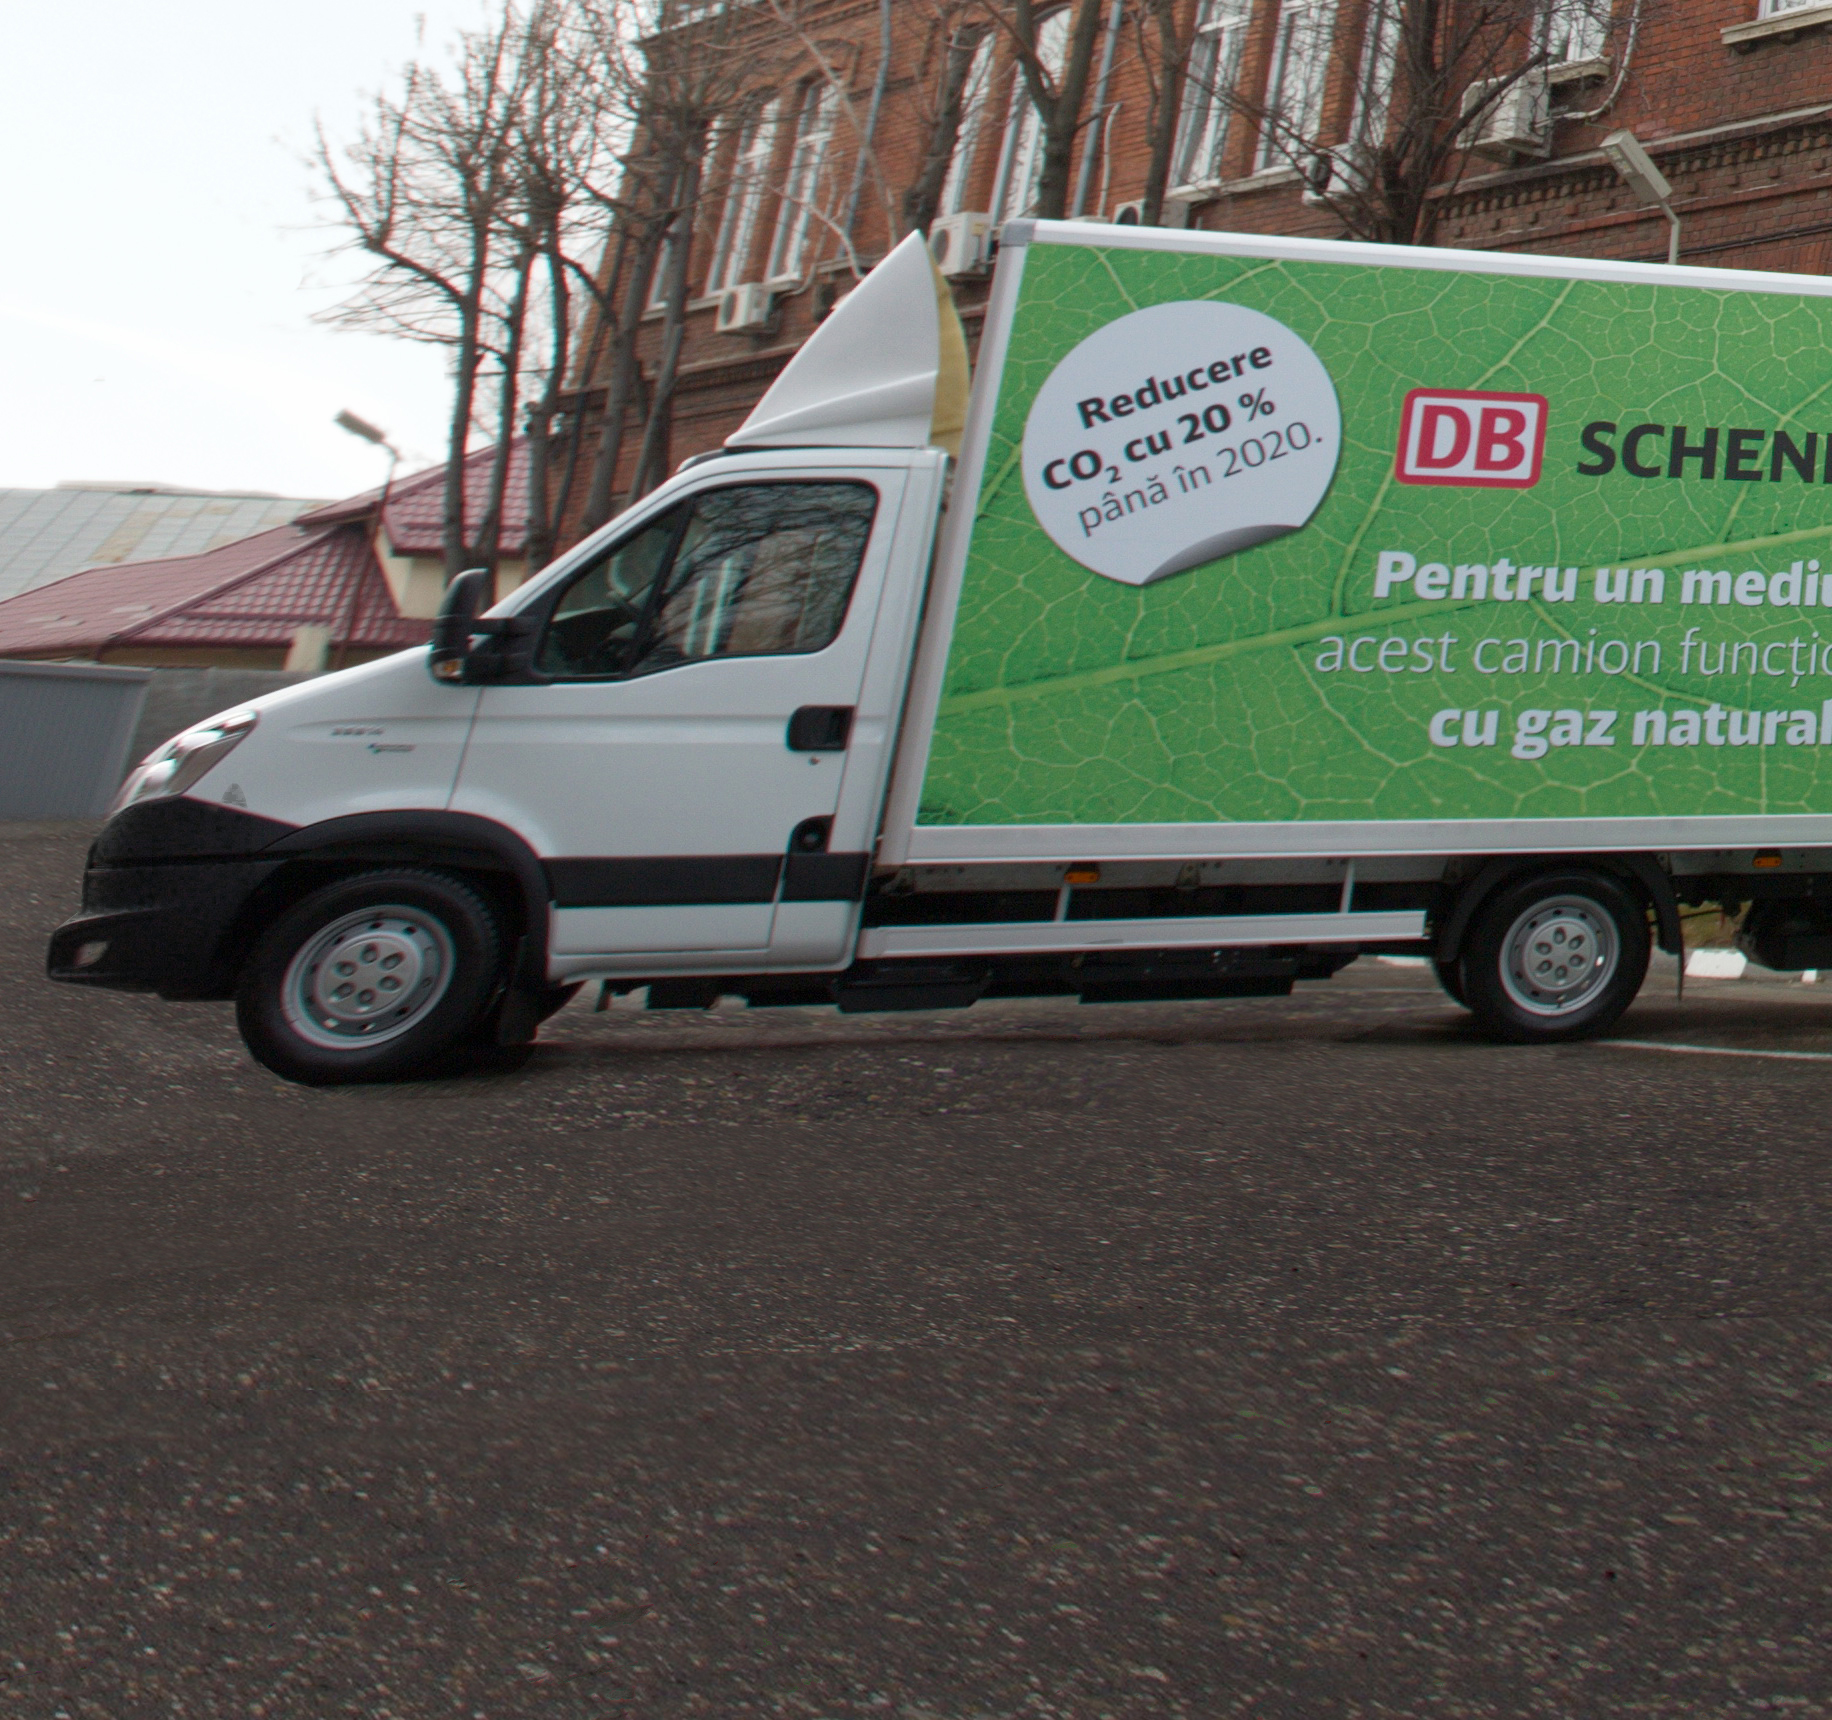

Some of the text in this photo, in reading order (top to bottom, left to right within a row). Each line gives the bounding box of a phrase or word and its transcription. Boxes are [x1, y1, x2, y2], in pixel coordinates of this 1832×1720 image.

[1077, 346, 1273, 429] Reducere
[1124, 430, 1173, 463] cu
[1177, 403, 1232, 445] 20
[1238, 387, 1276, 422] %
[1416, 404, 1527, 471] DB
[1078, 421, 1323, 538] până în 2020.
[1373, 551, 1579, 602] Pentru
[1593, 566, 1665, 604] un
[1315, 632, 1458, 673] acest
[1473, 629, 1662, 675] camion
[1428, 708, 1499, 747] cu
[1511, 709, 1618, 760] gaz
